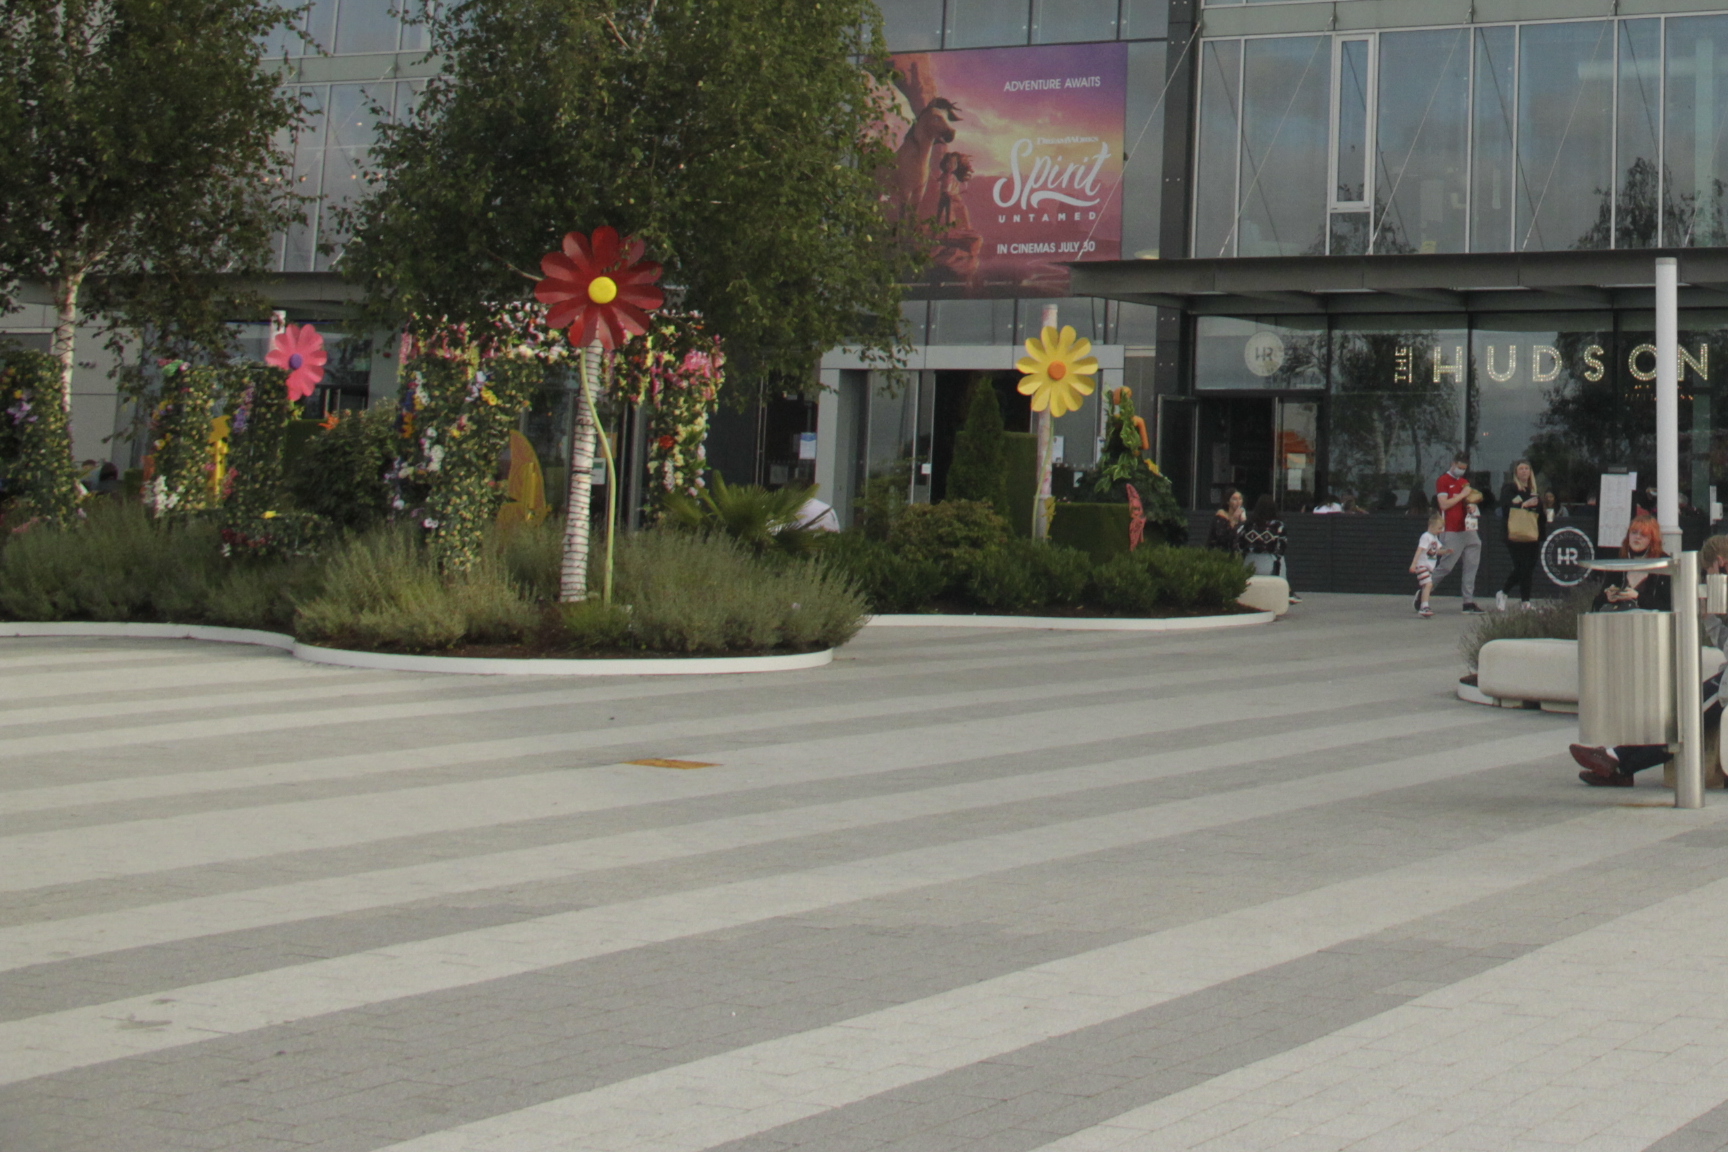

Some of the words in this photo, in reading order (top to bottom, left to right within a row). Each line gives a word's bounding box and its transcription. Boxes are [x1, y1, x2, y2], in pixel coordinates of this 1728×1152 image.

[1003, 79, 1061, 92] ADVENTURE
[1064, 76, 1101, 89] AWAITS
[992, 138, 1112, 210] Spirit
[998, 212, 1096, 223] UNTAMED
[997, 244, 1007, 254] IN
[1010, 242, 1056, 254] CINEMAS
[1058, 241, 1080, 253] JULY
[1082, 241, 1096, 252] 30
[1394, 346, 1407, 383] THE
[1432, 342, 1709, 383] HUDSON
[1557, 547, 1579, 565] HR
